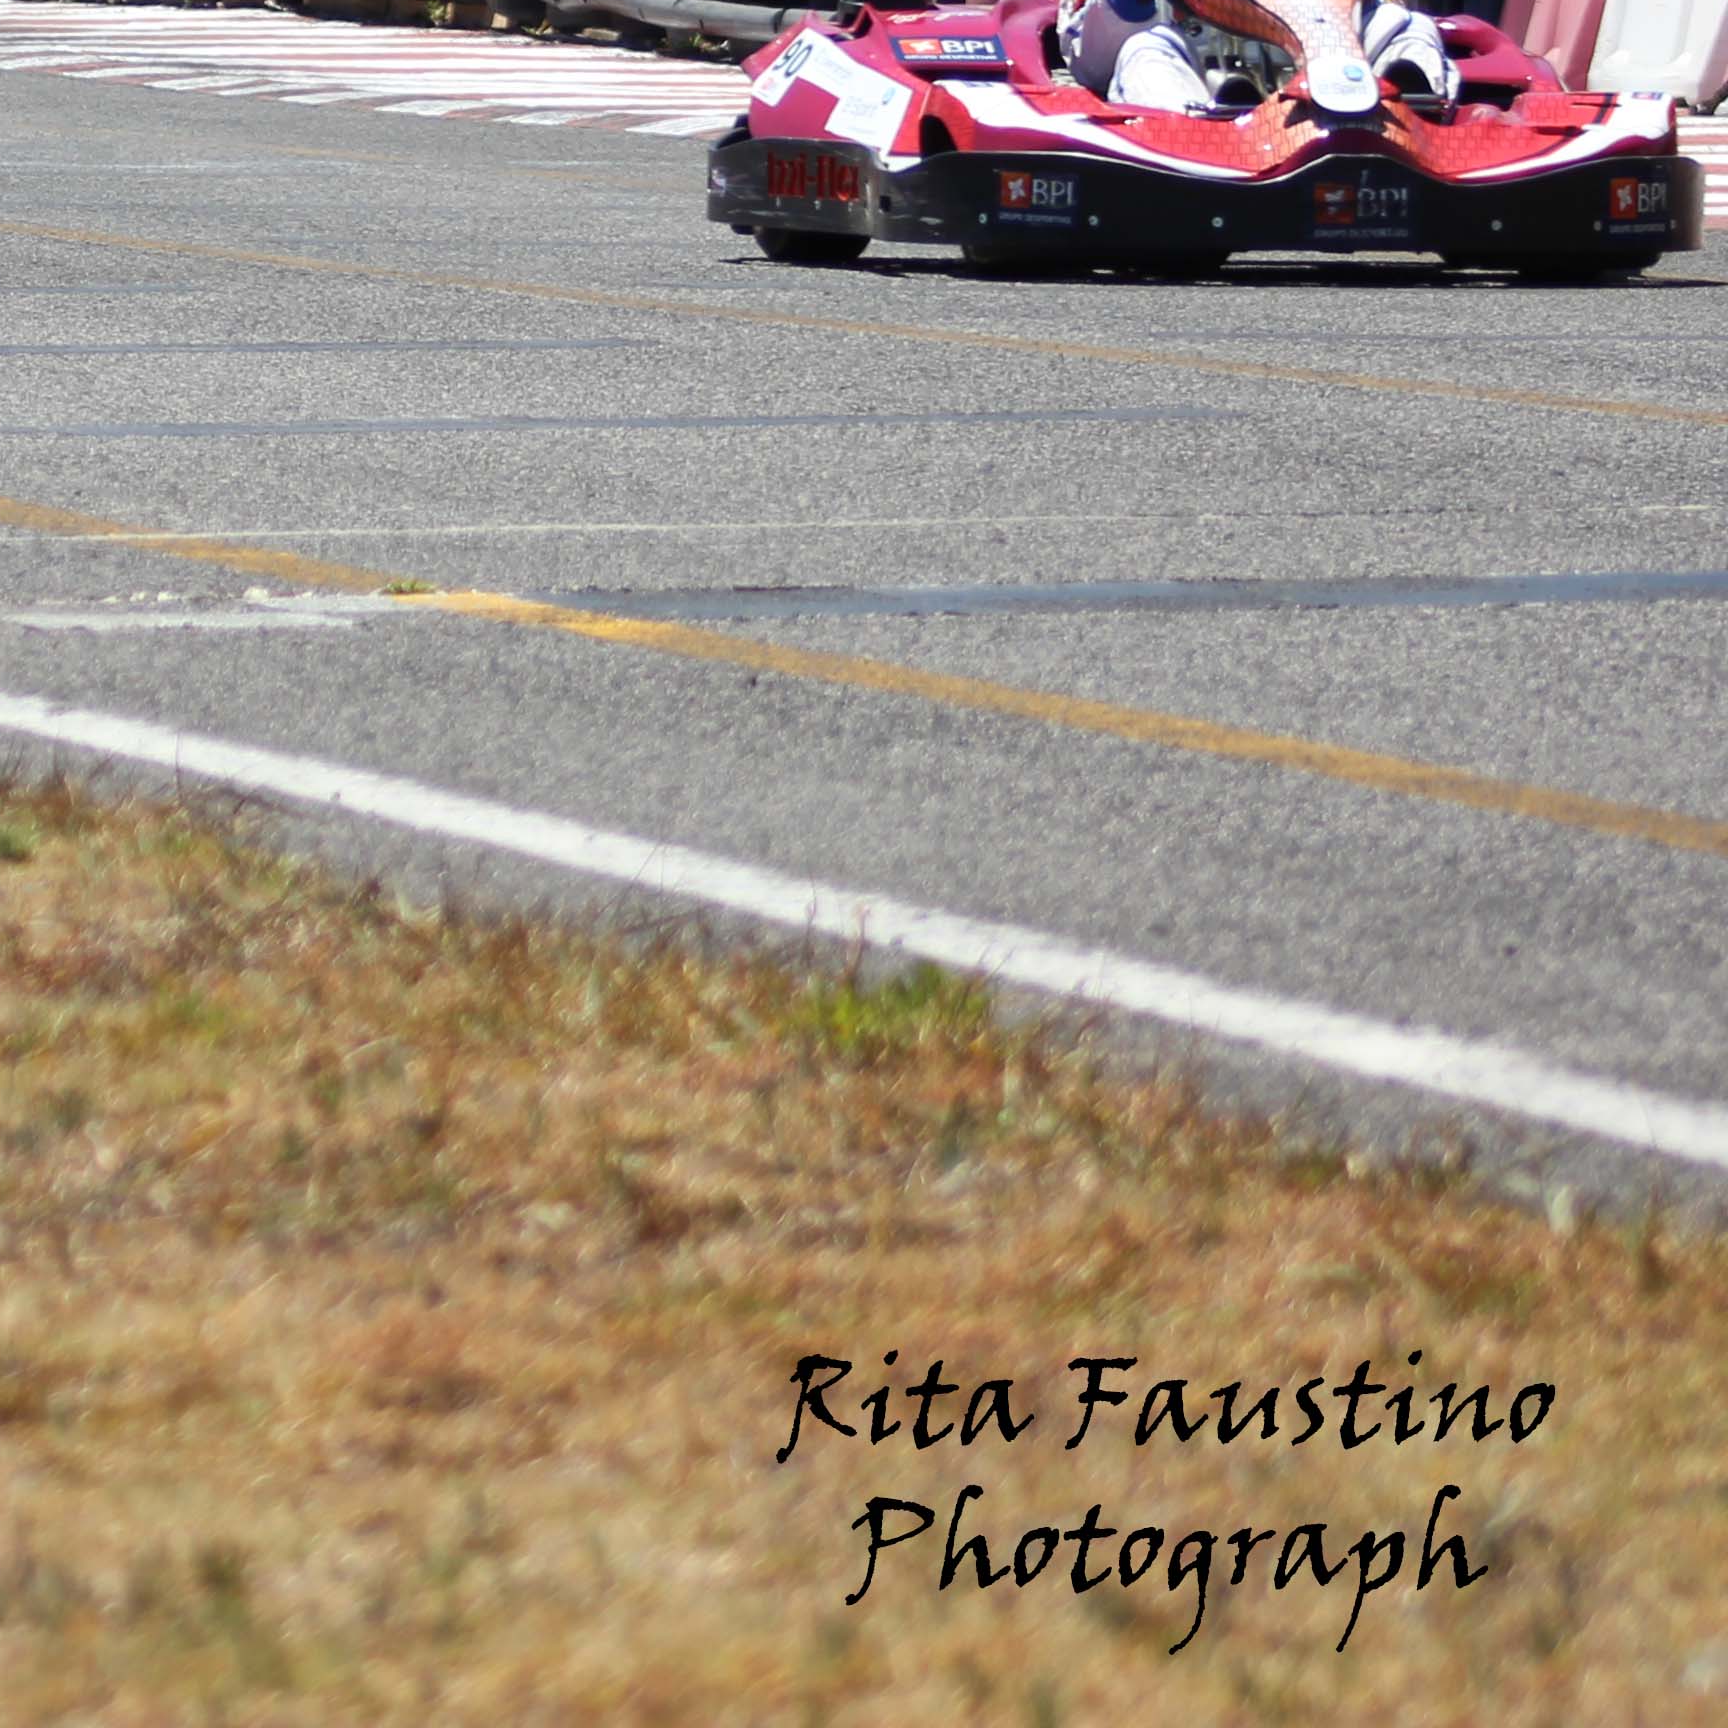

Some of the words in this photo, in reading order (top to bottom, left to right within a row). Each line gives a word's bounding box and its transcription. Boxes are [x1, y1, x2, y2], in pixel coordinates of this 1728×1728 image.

[772, 39, 813, 77] 90
[940, 40, 996, 53] BPI
[1032, 178, 1074, 206] BPI
[1637, 182, 1667, 213] BPI
